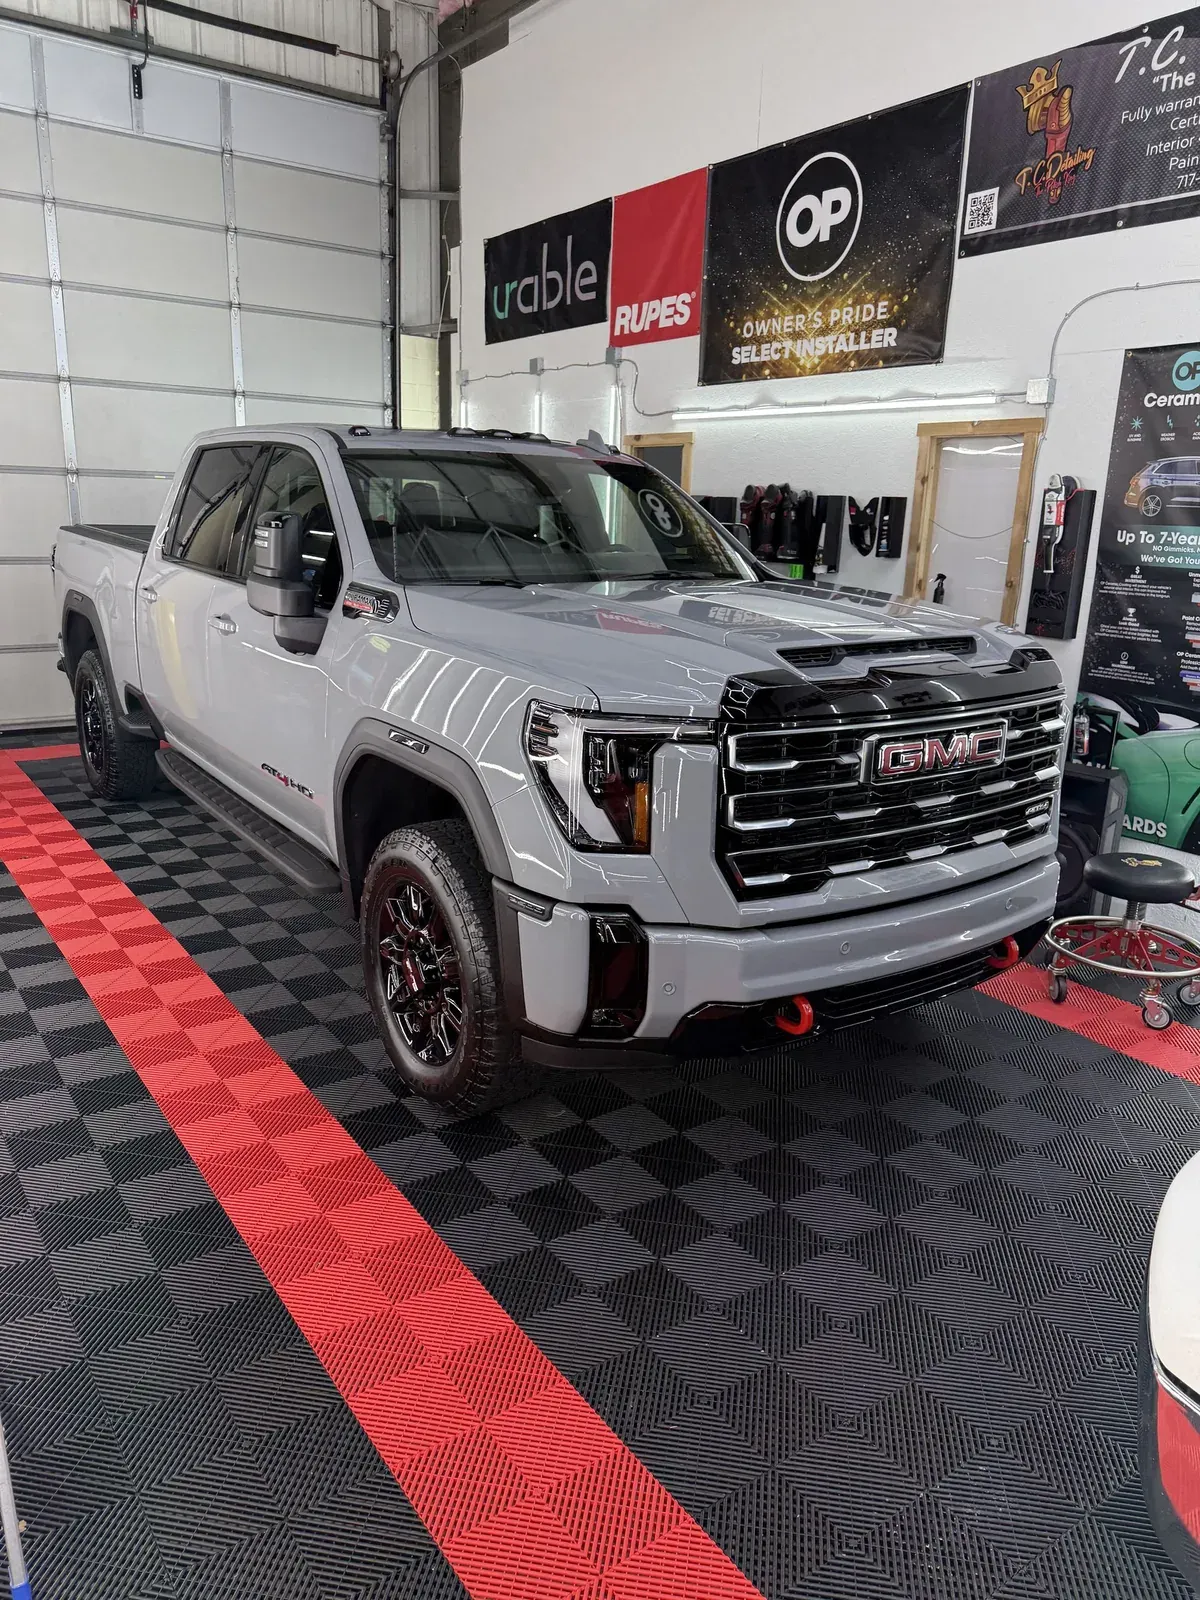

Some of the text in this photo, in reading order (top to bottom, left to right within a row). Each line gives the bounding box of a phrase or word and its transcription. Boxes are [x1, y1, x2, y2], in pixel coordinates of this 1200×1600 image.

[1115, 26, 1186, 83] T.C.
[1121, 106, 1152, 124] Fully
[1146, 136, 1195, 156] Interior
[1168, 154, 1199, 170] Pain
[786, 187, 852, 247] OP
[493, 235, 598, 319] urable
[743, 301, 889, 338] OWNER'S PRIDE
[731, 327, 898, 365] SELECT INSTALLER
[1117, 530, 1136, 545] Up
[1140, 530, 1155, 544] To
[1140, 554, 1166, 563] We've
[1167, 556, 1183, 564] Got
[878, 729, 1002, 776] GMC
